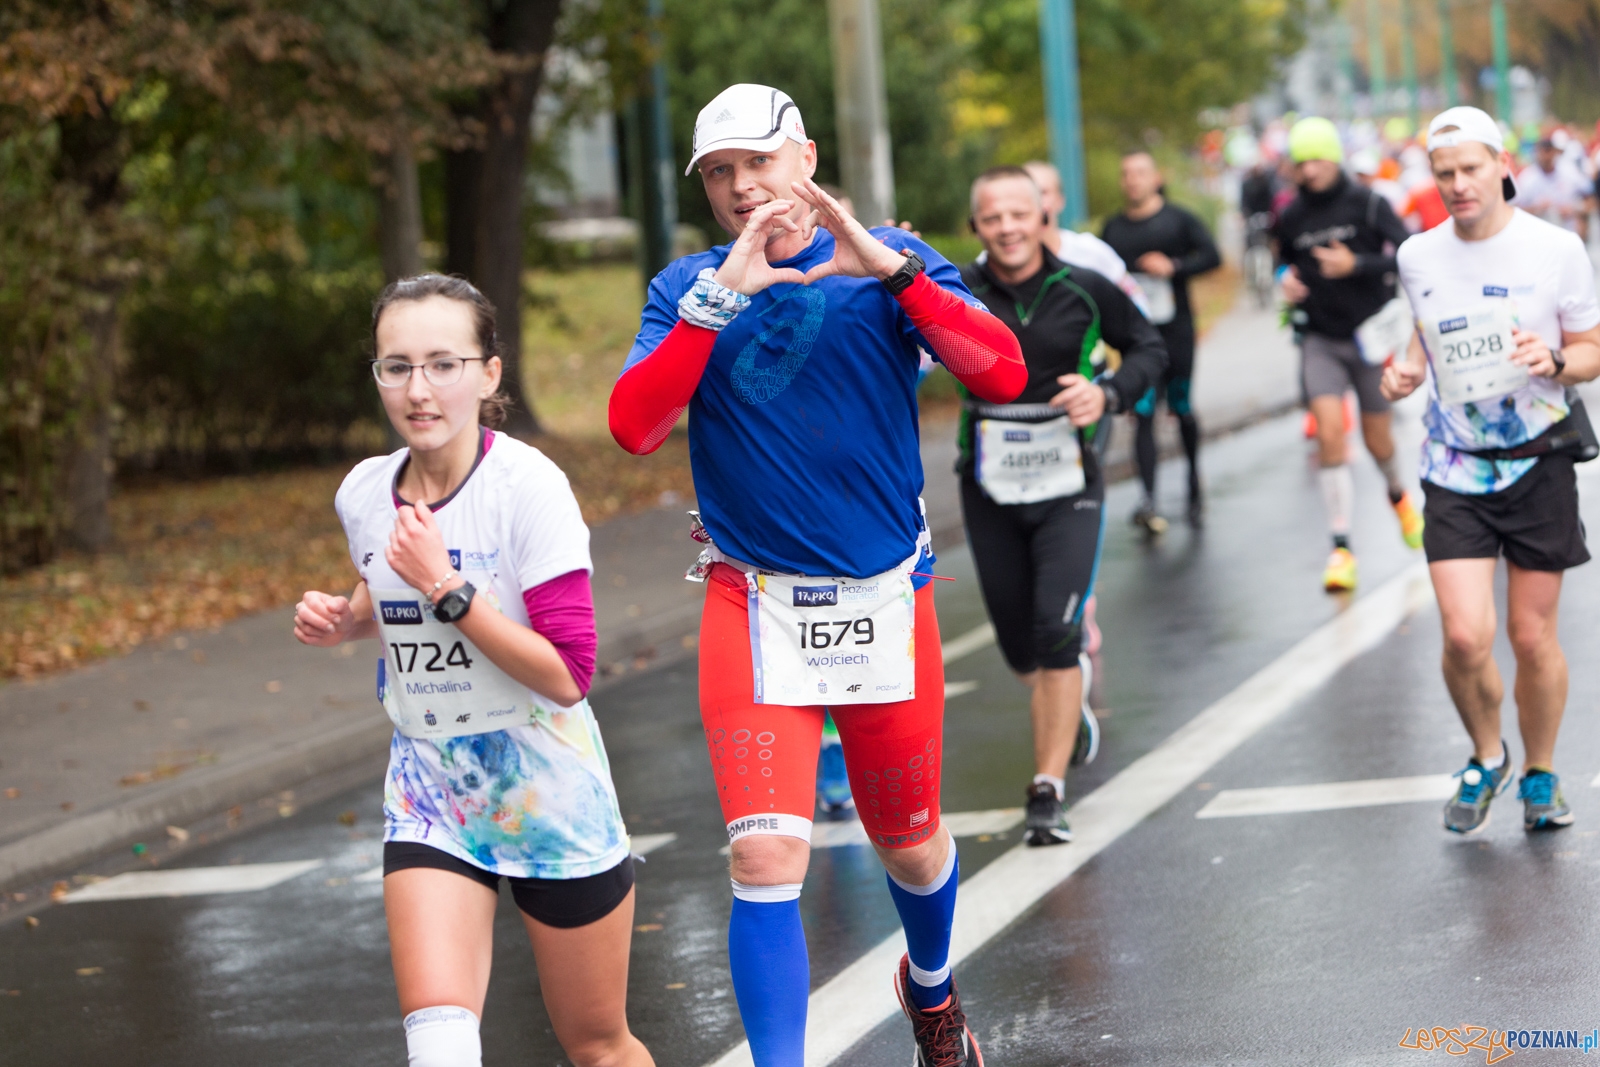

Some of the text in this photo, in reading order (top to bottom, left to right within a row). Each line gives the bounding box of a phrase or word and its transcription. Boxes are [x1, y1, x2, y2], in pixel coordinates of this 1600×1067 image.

[1443, 333, 1503, 363] 2028
[842, 591, 879, 601] maraton
[383, 607, 418, 618] 17.PKO
[798, 617, 874, 649] 1679
[390, 641, 473, 673] 1724
[807, 653, 869, 667] Wojciech
[406, 680, 472, 694] Michalina
[846, 683, 862, 693] 4F
[456, 713, 471, 723] 4F
